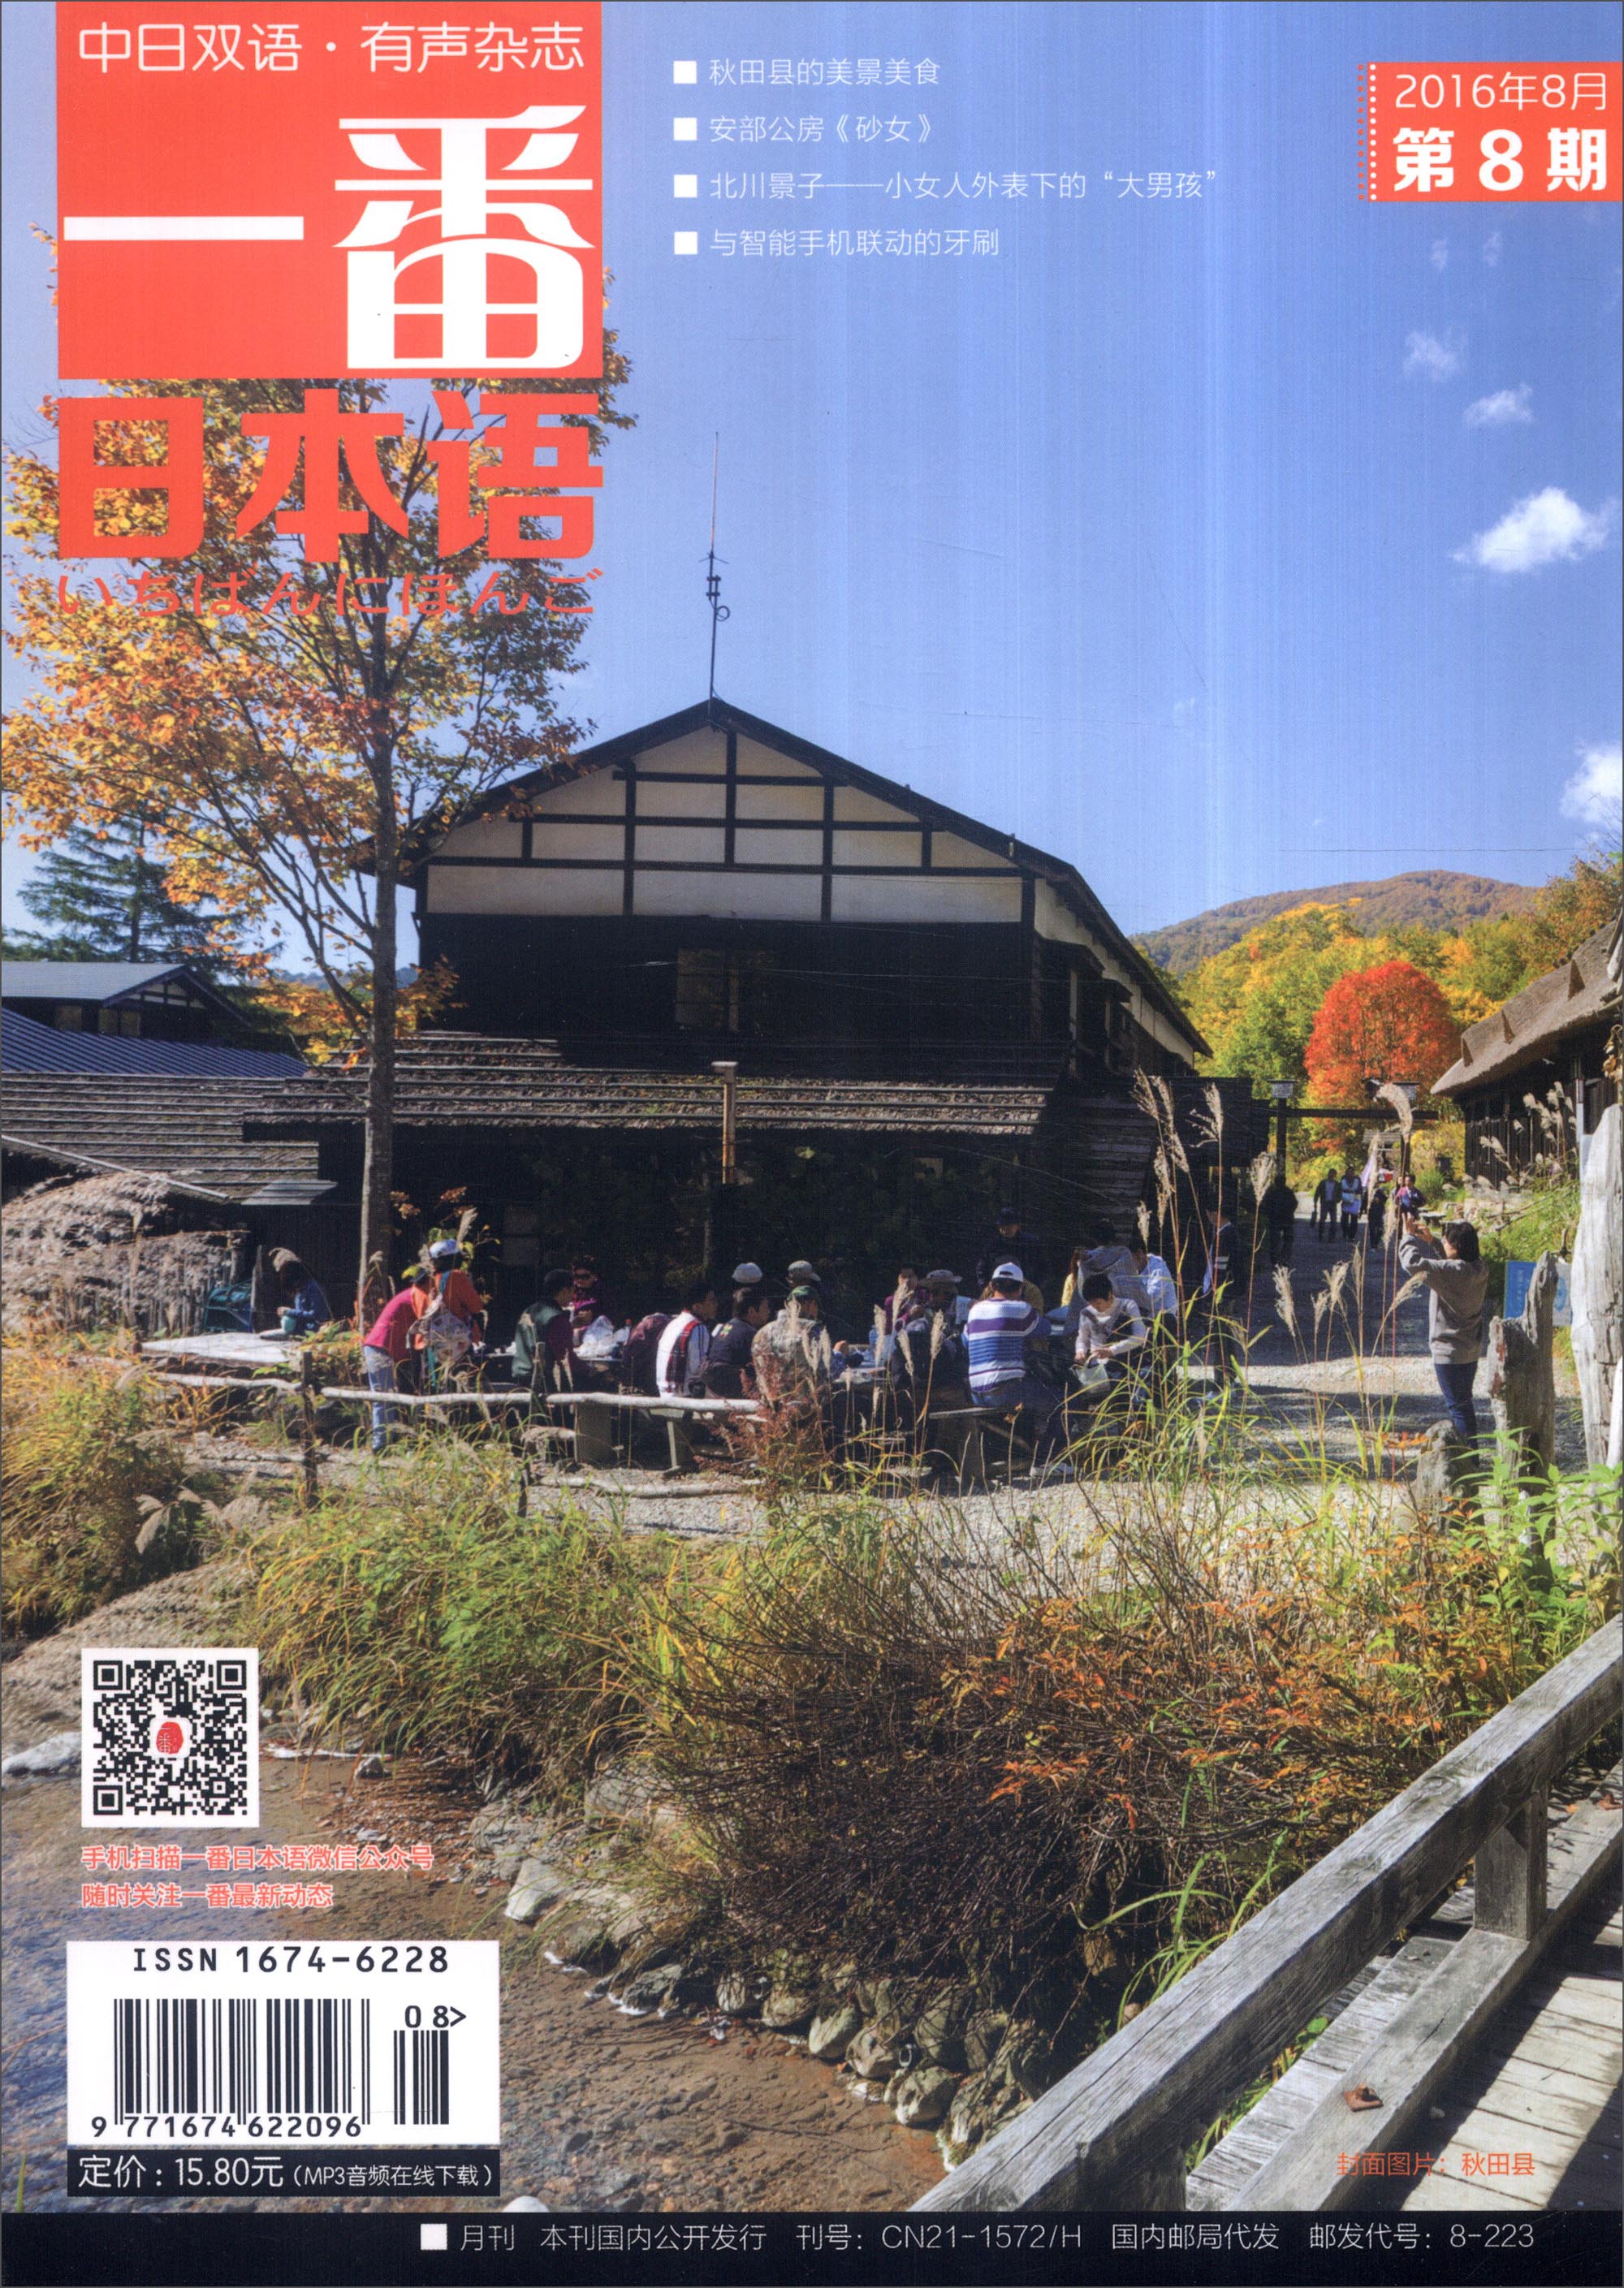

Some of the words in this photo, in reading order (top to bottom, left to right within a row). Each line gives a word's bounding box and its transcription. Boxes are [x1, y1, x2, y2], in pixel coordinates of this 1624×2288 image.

[80, 21, 584, 73] 中日双语·有声杂志
[708, 58, 941, 86] 秋田县的美景美食
[1395, 71, 1606, 110] 2016年8月
[708, 114, 932, 143] 安部公房《砂女》
[63, 105, 595, 369] 一番
[709, 228, 1000, 257] 与智能手机联动的牙刷
[58, 388, 604, 563] 日本语
[58, 567, 604, 618] いちばんにほんご
[81, 1845, 434, 1871] 手机扫描一番日本语微信公众号
[81, 1883, 334, 1908] 随时关注一番最新动态
[133, 1948, 217, 1972] ISSN
[235, 1945, 448, 1973] 1674-6228
[460, 2224, 515, 2252] 月刊
[540, 2223, 767, 2252] 本刊国内公开发行
[1112, 2222, 1281, 2251] 国内邮局代发
